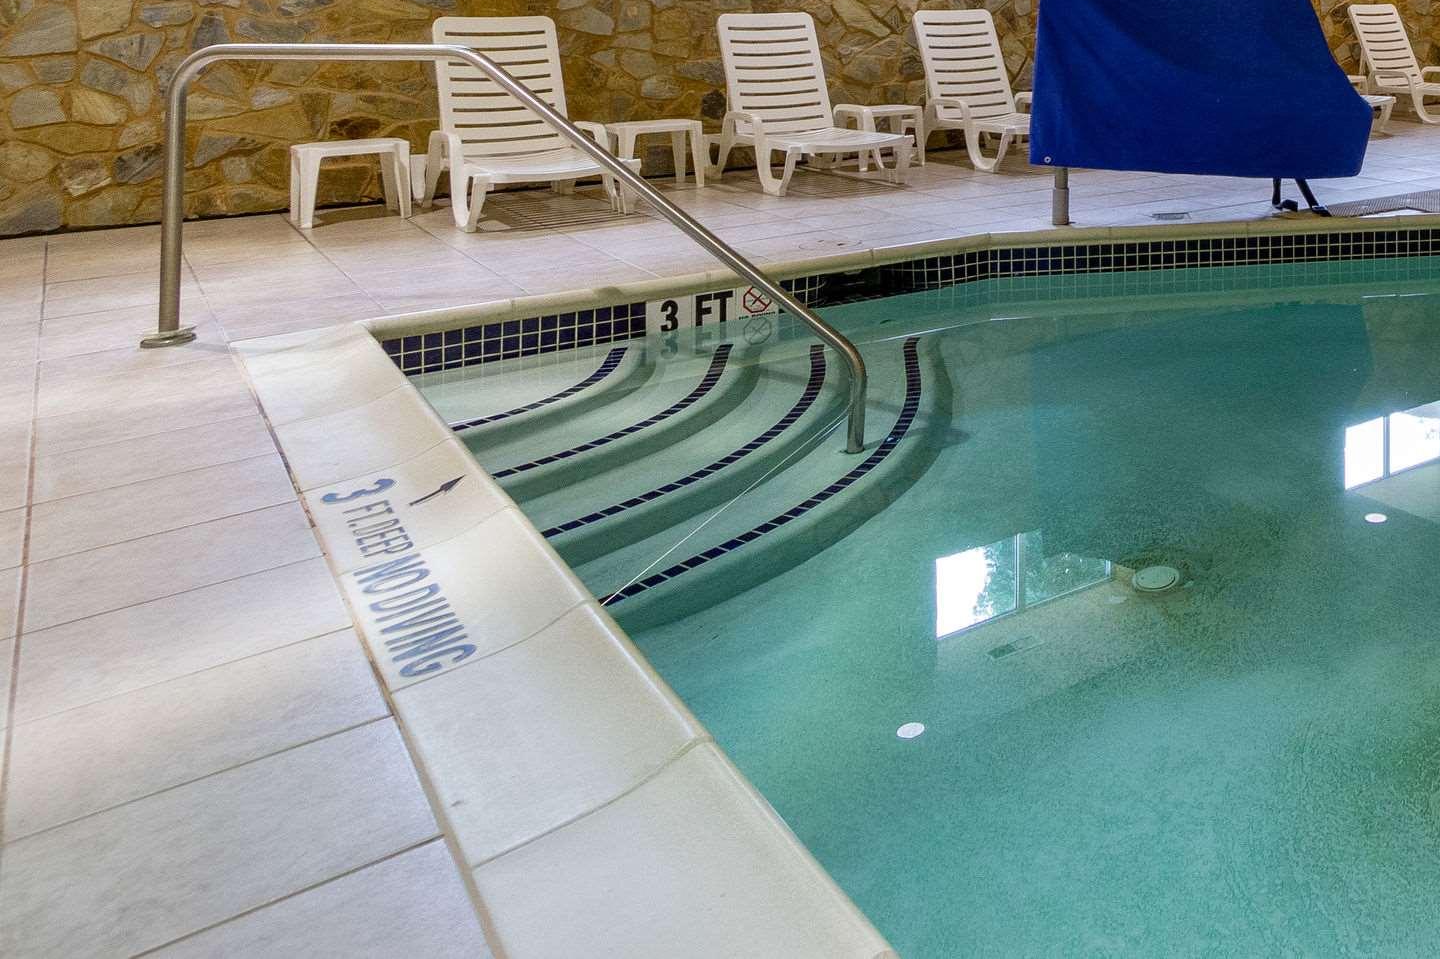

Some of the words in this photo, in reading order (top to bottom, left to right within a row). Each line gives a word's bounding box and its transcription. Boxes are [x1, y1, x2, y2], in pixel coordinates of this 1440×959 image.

[660, 300, 679, 332] 3
[694, 290, 734, 327] FT
[321, 478, 397, 505] 3
